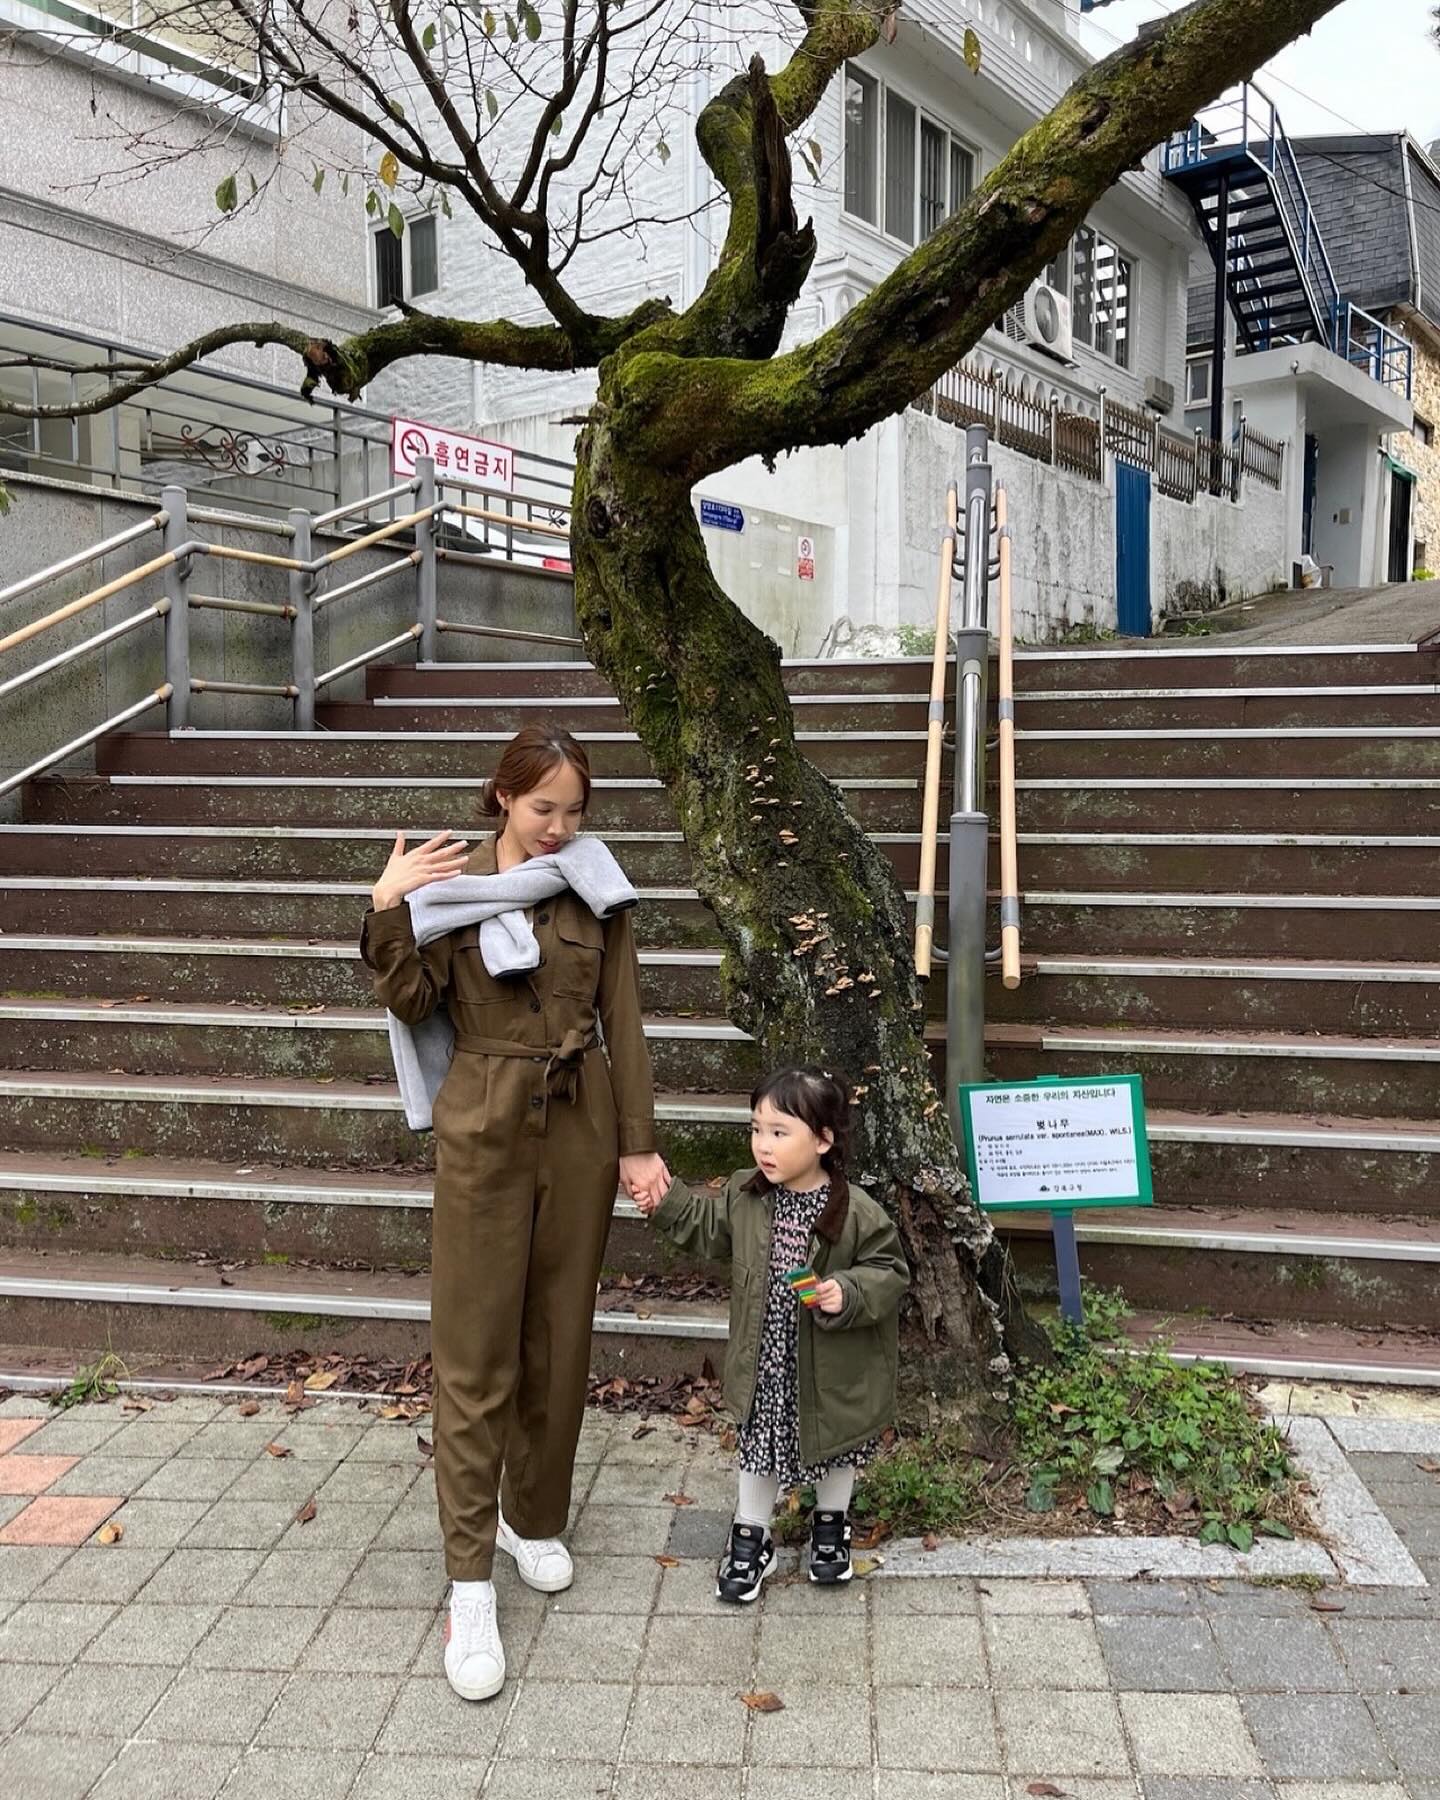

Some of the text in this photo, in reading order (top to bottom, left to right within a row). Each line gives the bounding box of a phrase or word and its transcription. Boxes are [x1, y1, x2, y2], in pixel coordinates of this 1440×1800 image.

[434, 441, 507, 481] 흡연금지
[985, 1087, 1116, 1104] 자연은 소중한 우리의 자산입니다
